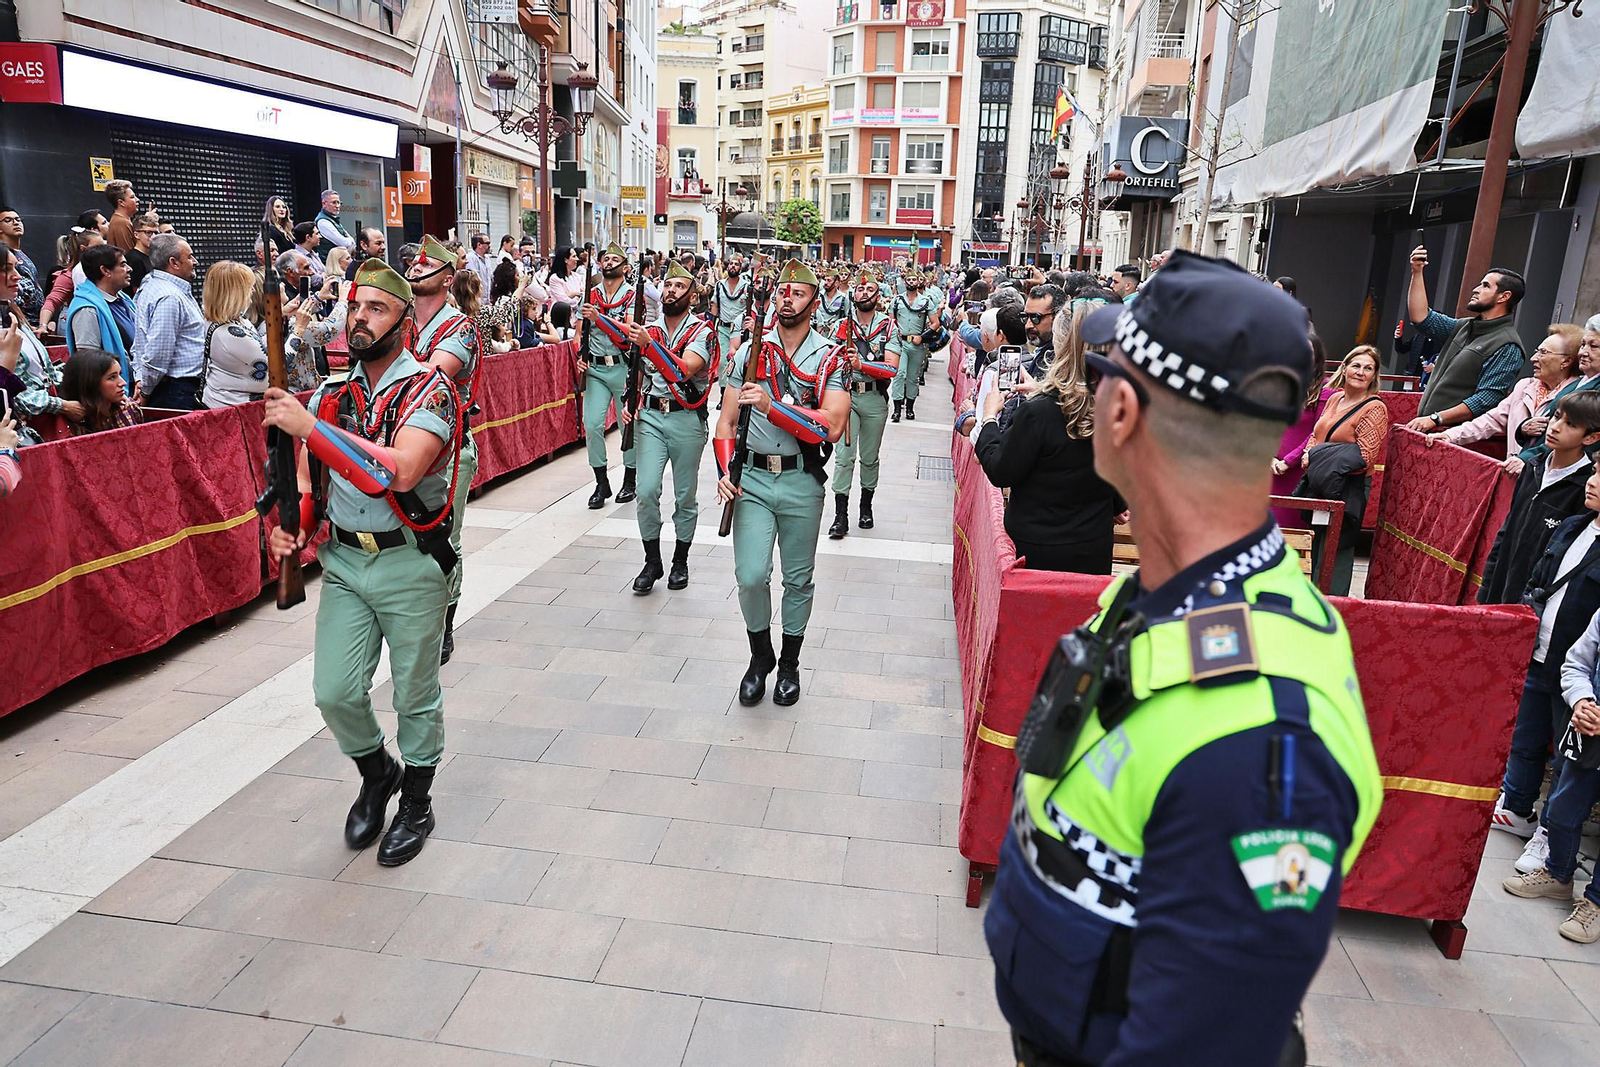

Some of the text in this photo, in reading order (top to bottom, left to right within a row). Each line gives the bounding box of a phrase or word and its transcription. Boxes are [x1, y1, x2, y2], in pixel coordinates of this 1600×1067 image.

[1, 61, 44, 77] GAES
[1131, 126, 1170, 174] C
[1124, 176, 1176, 188] ORTEFIEL
[390, 191, 397, 217] 5
